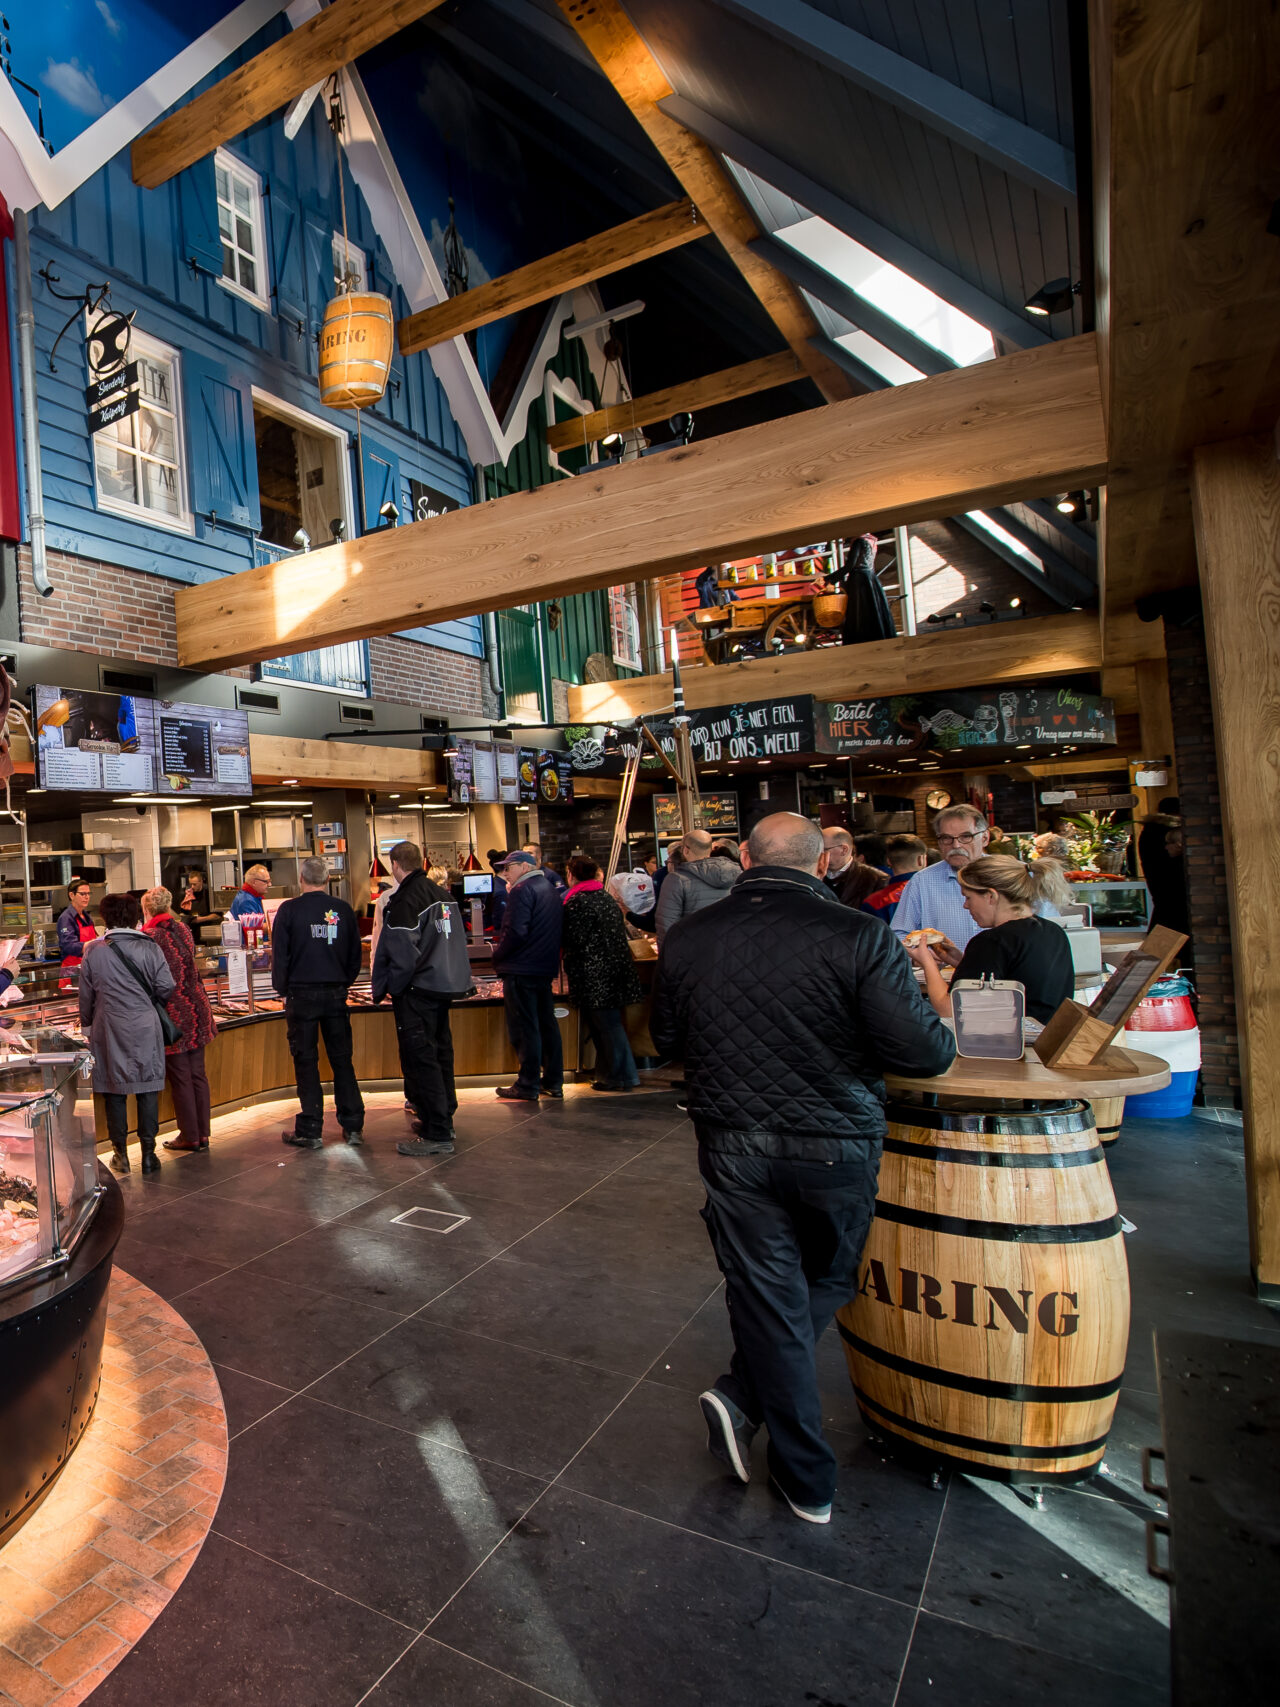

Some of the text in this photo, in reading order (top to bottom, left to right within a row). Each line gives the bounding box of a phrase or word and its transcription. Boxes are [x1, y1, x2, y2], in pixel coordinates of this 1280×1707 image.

[711, 718, 732, 740] KUN
[734, 713, 746, 732] JE
[748, 708, 768, 729] NIET
[772, 704, 804, 725] ETEN...
[832, 702, 876, 722] Bestel
[829, 720, 872, 737] HIER
[844, 739, 863, 747] menu
[882, 735, 894, 746] de
[896, 734, 914, 746] bar
[704, 731, 800, 762] BIJ ONS WEL!!
[858, 1258, 1080, 1337] ARING
